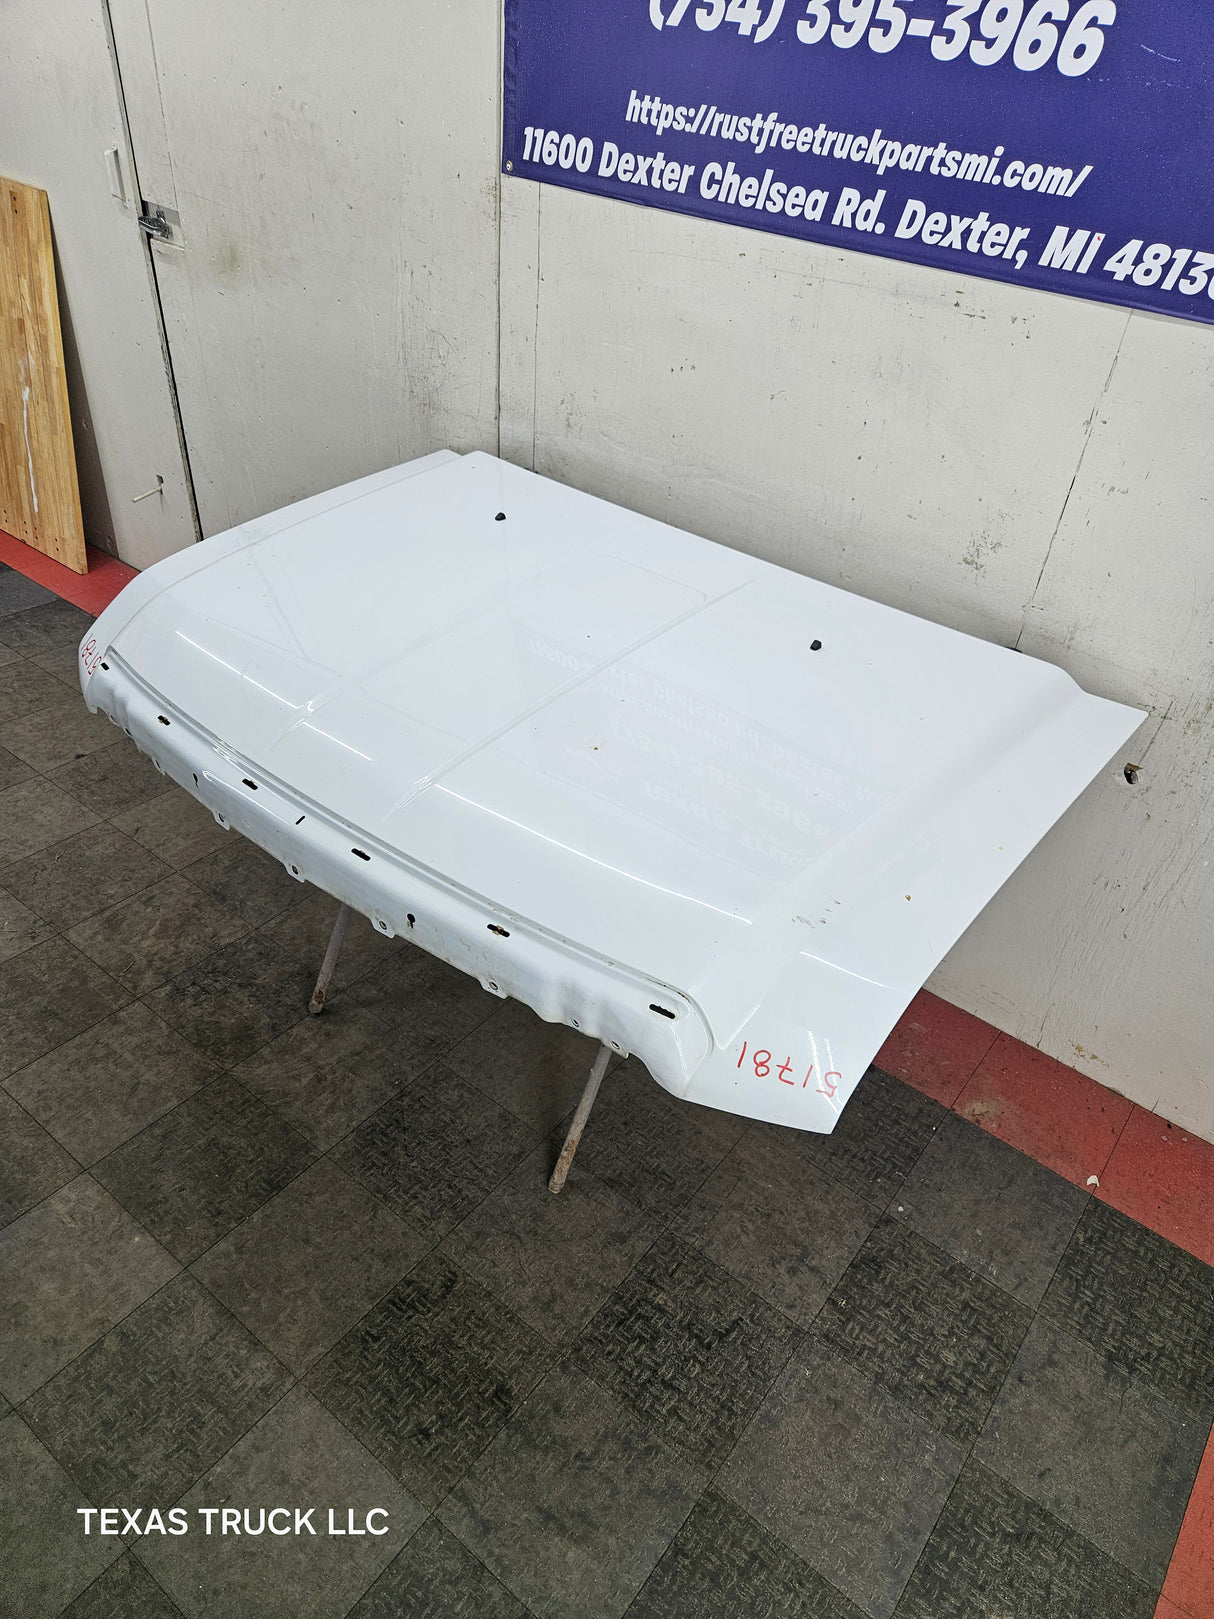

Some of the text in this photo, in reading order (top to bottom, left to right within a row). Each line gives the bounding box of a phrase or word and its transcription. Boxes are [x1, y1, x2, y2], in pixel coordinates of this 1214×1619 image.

[796, 0, 1117, 77] 395-3966
[625, 89, 1094, 199] https://rustfreetruckpartsmi.com/
[522, 126, 1214, 300] 11600 Dexter Chelsea Rd. Dexter, MI 4813
[737, 1041, 842, 1098] 51781
